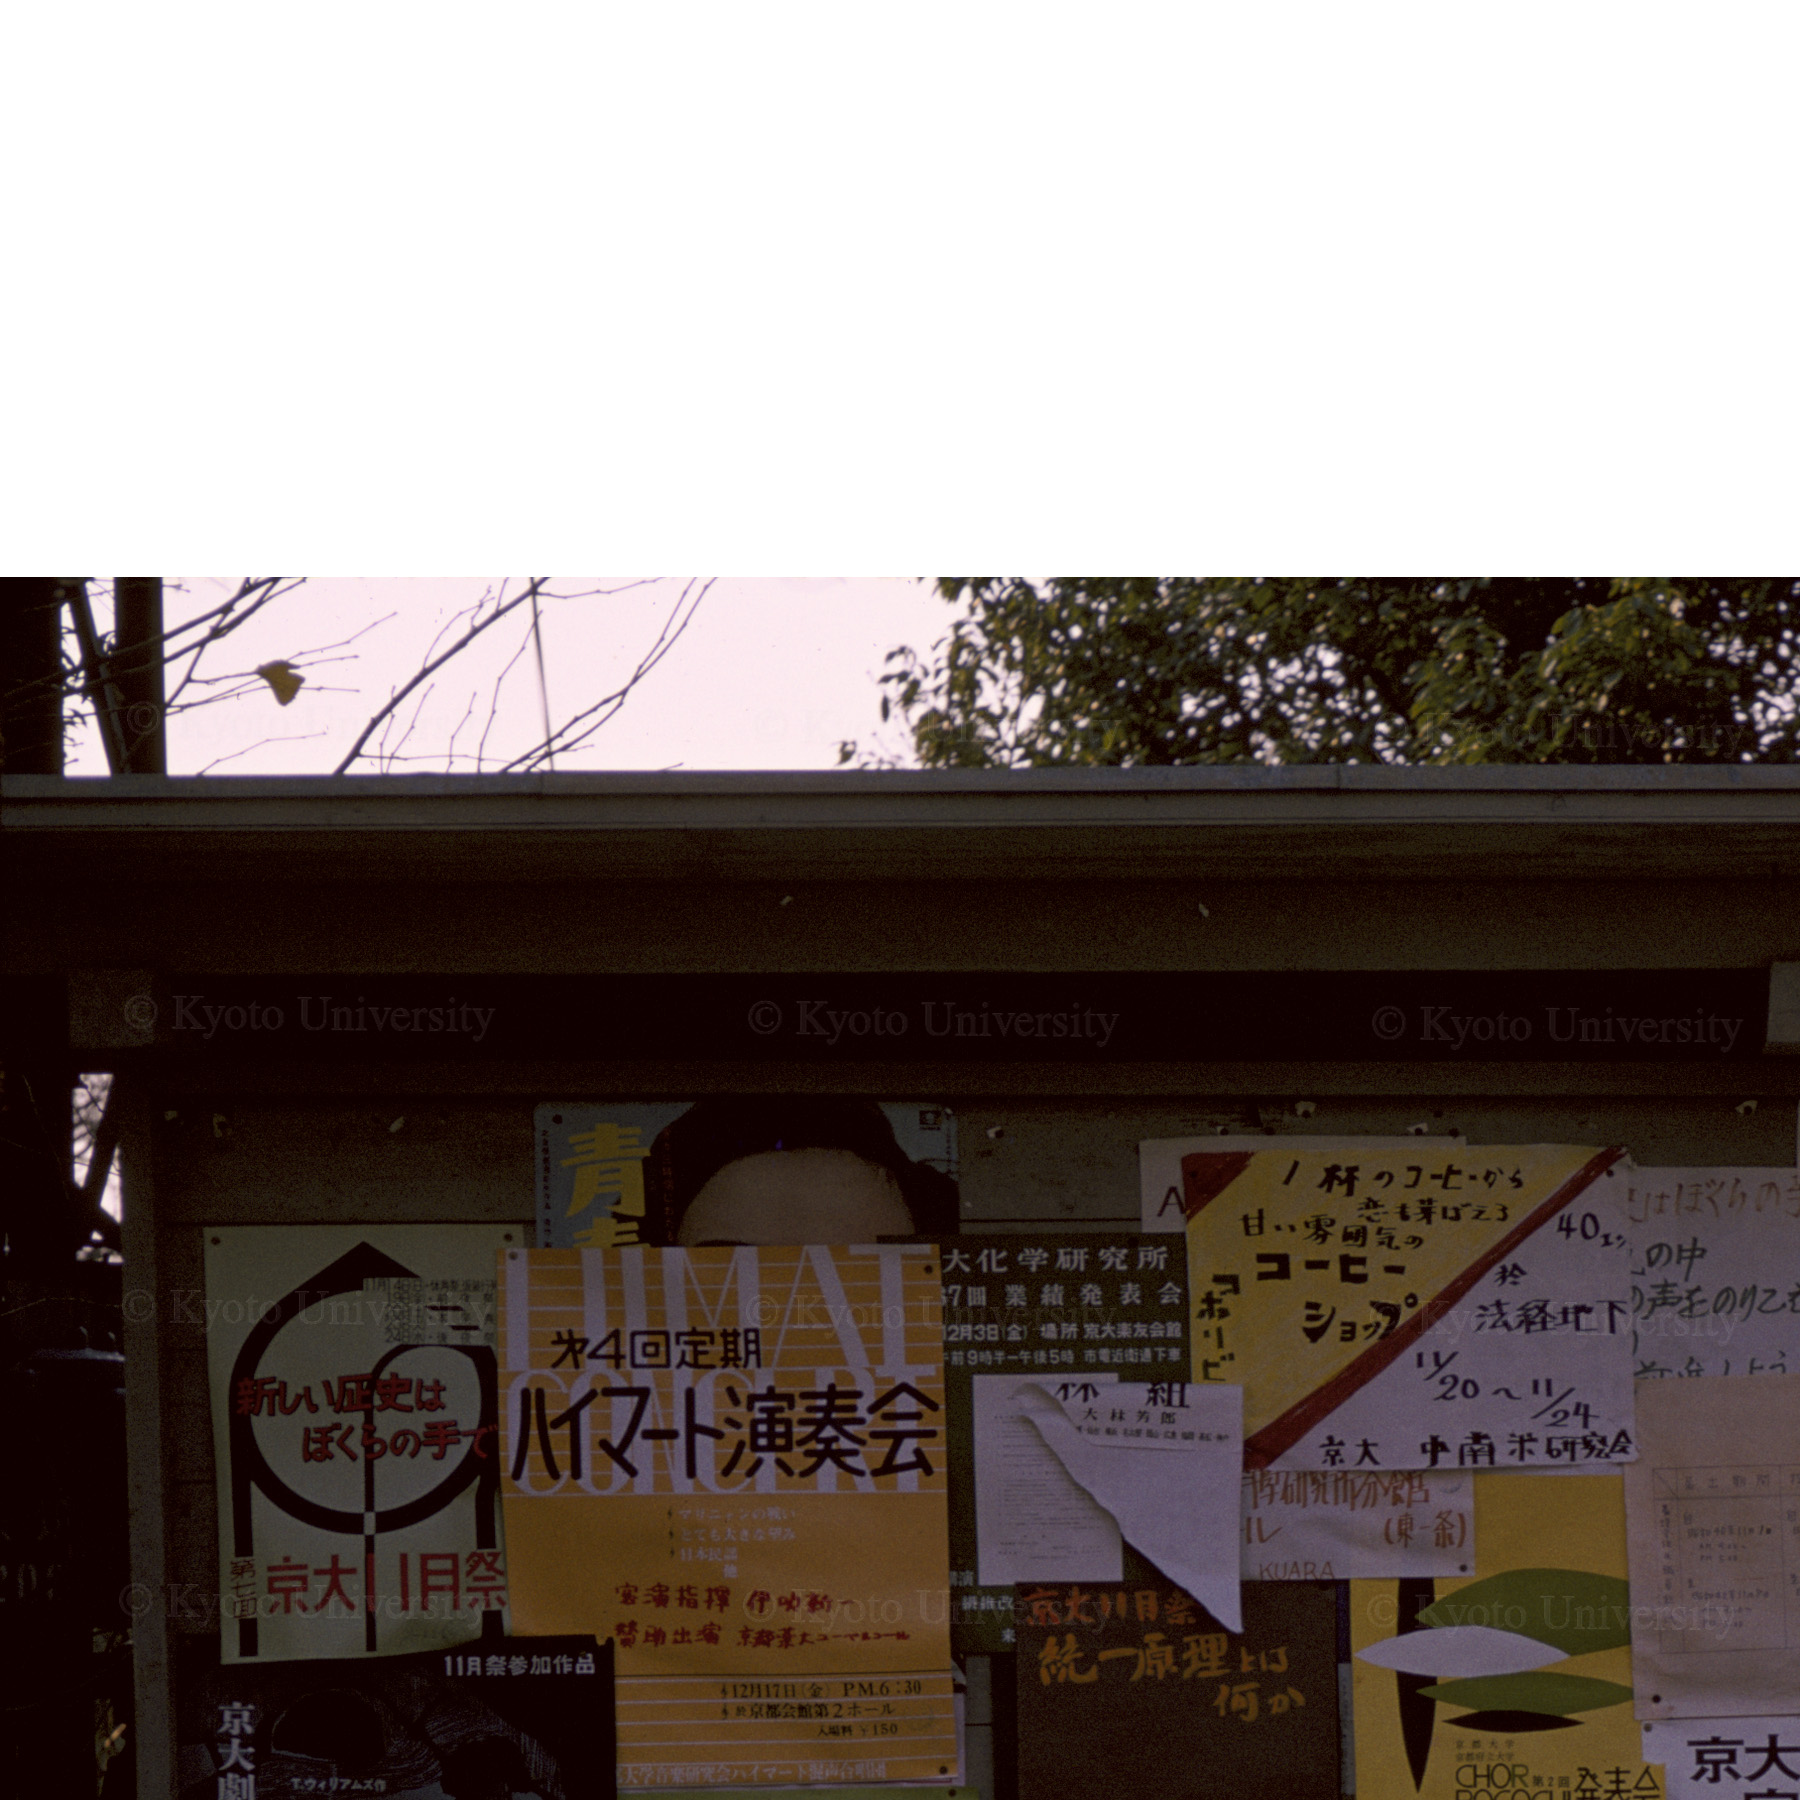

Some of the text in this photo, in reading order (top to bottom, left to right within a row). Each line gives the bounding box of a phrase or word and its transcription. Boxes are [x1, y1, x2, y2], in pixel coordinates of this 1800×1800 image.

[1257, 1253, 1406, 1283] コーヒー
[1302, 1292, 1418, 1343] ショップ
[1319, 1435, 1380, 1466] 京大
[444, 1653, 596, 1677] 11月祭参加作品
[1038, 1633, 1289, 1686] 統一原理とは
[1455, 1764, 1528, 1788] CHOR
